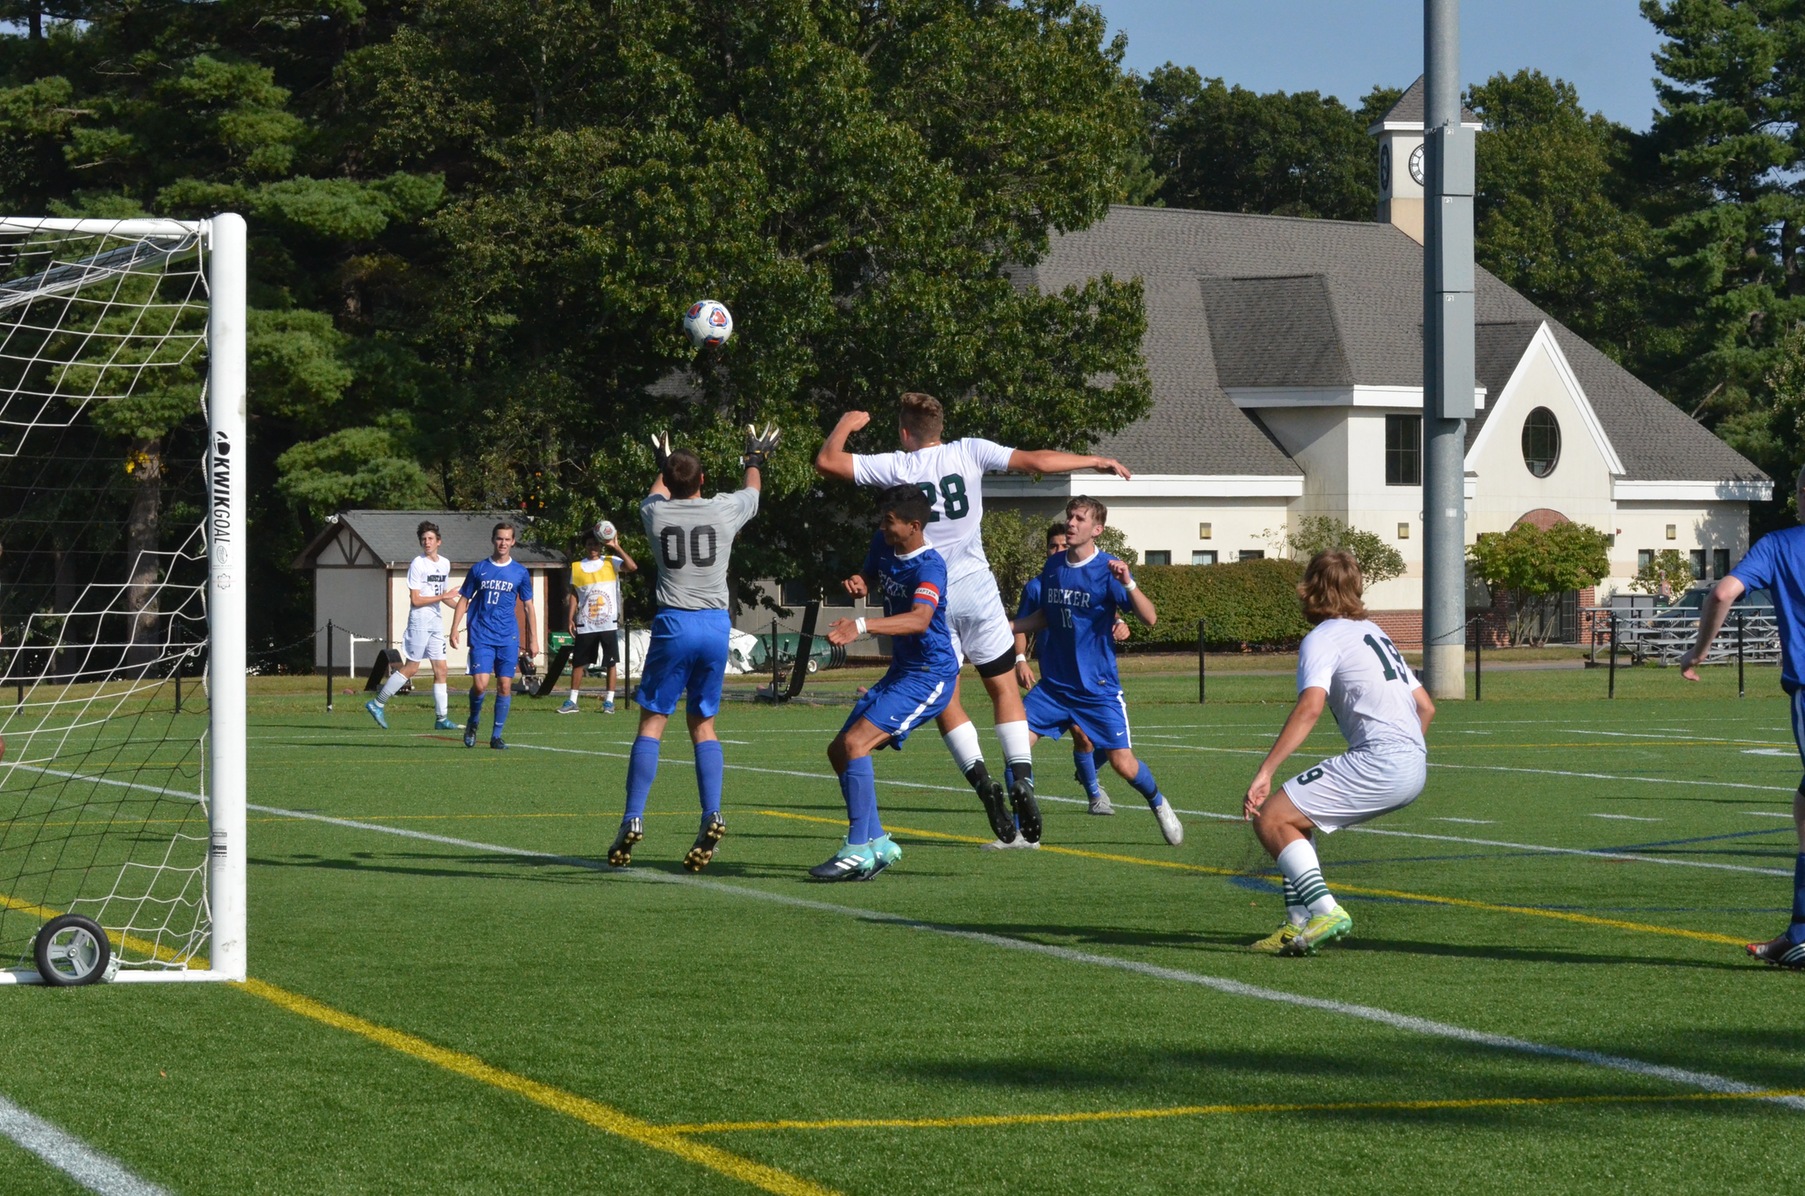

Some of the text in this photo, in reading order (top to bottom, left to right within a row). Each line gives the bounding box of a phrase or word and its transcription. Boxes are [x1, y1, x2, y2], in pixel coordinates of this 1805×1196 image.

[660, 525, 716, 570] 00
[486, 591, 500, 605] 13
[916, 588, 937, 597] CAPTAIN
[1047, 588, 1091, 608] BECKER
[1363, 633, 1409, 685] 19
